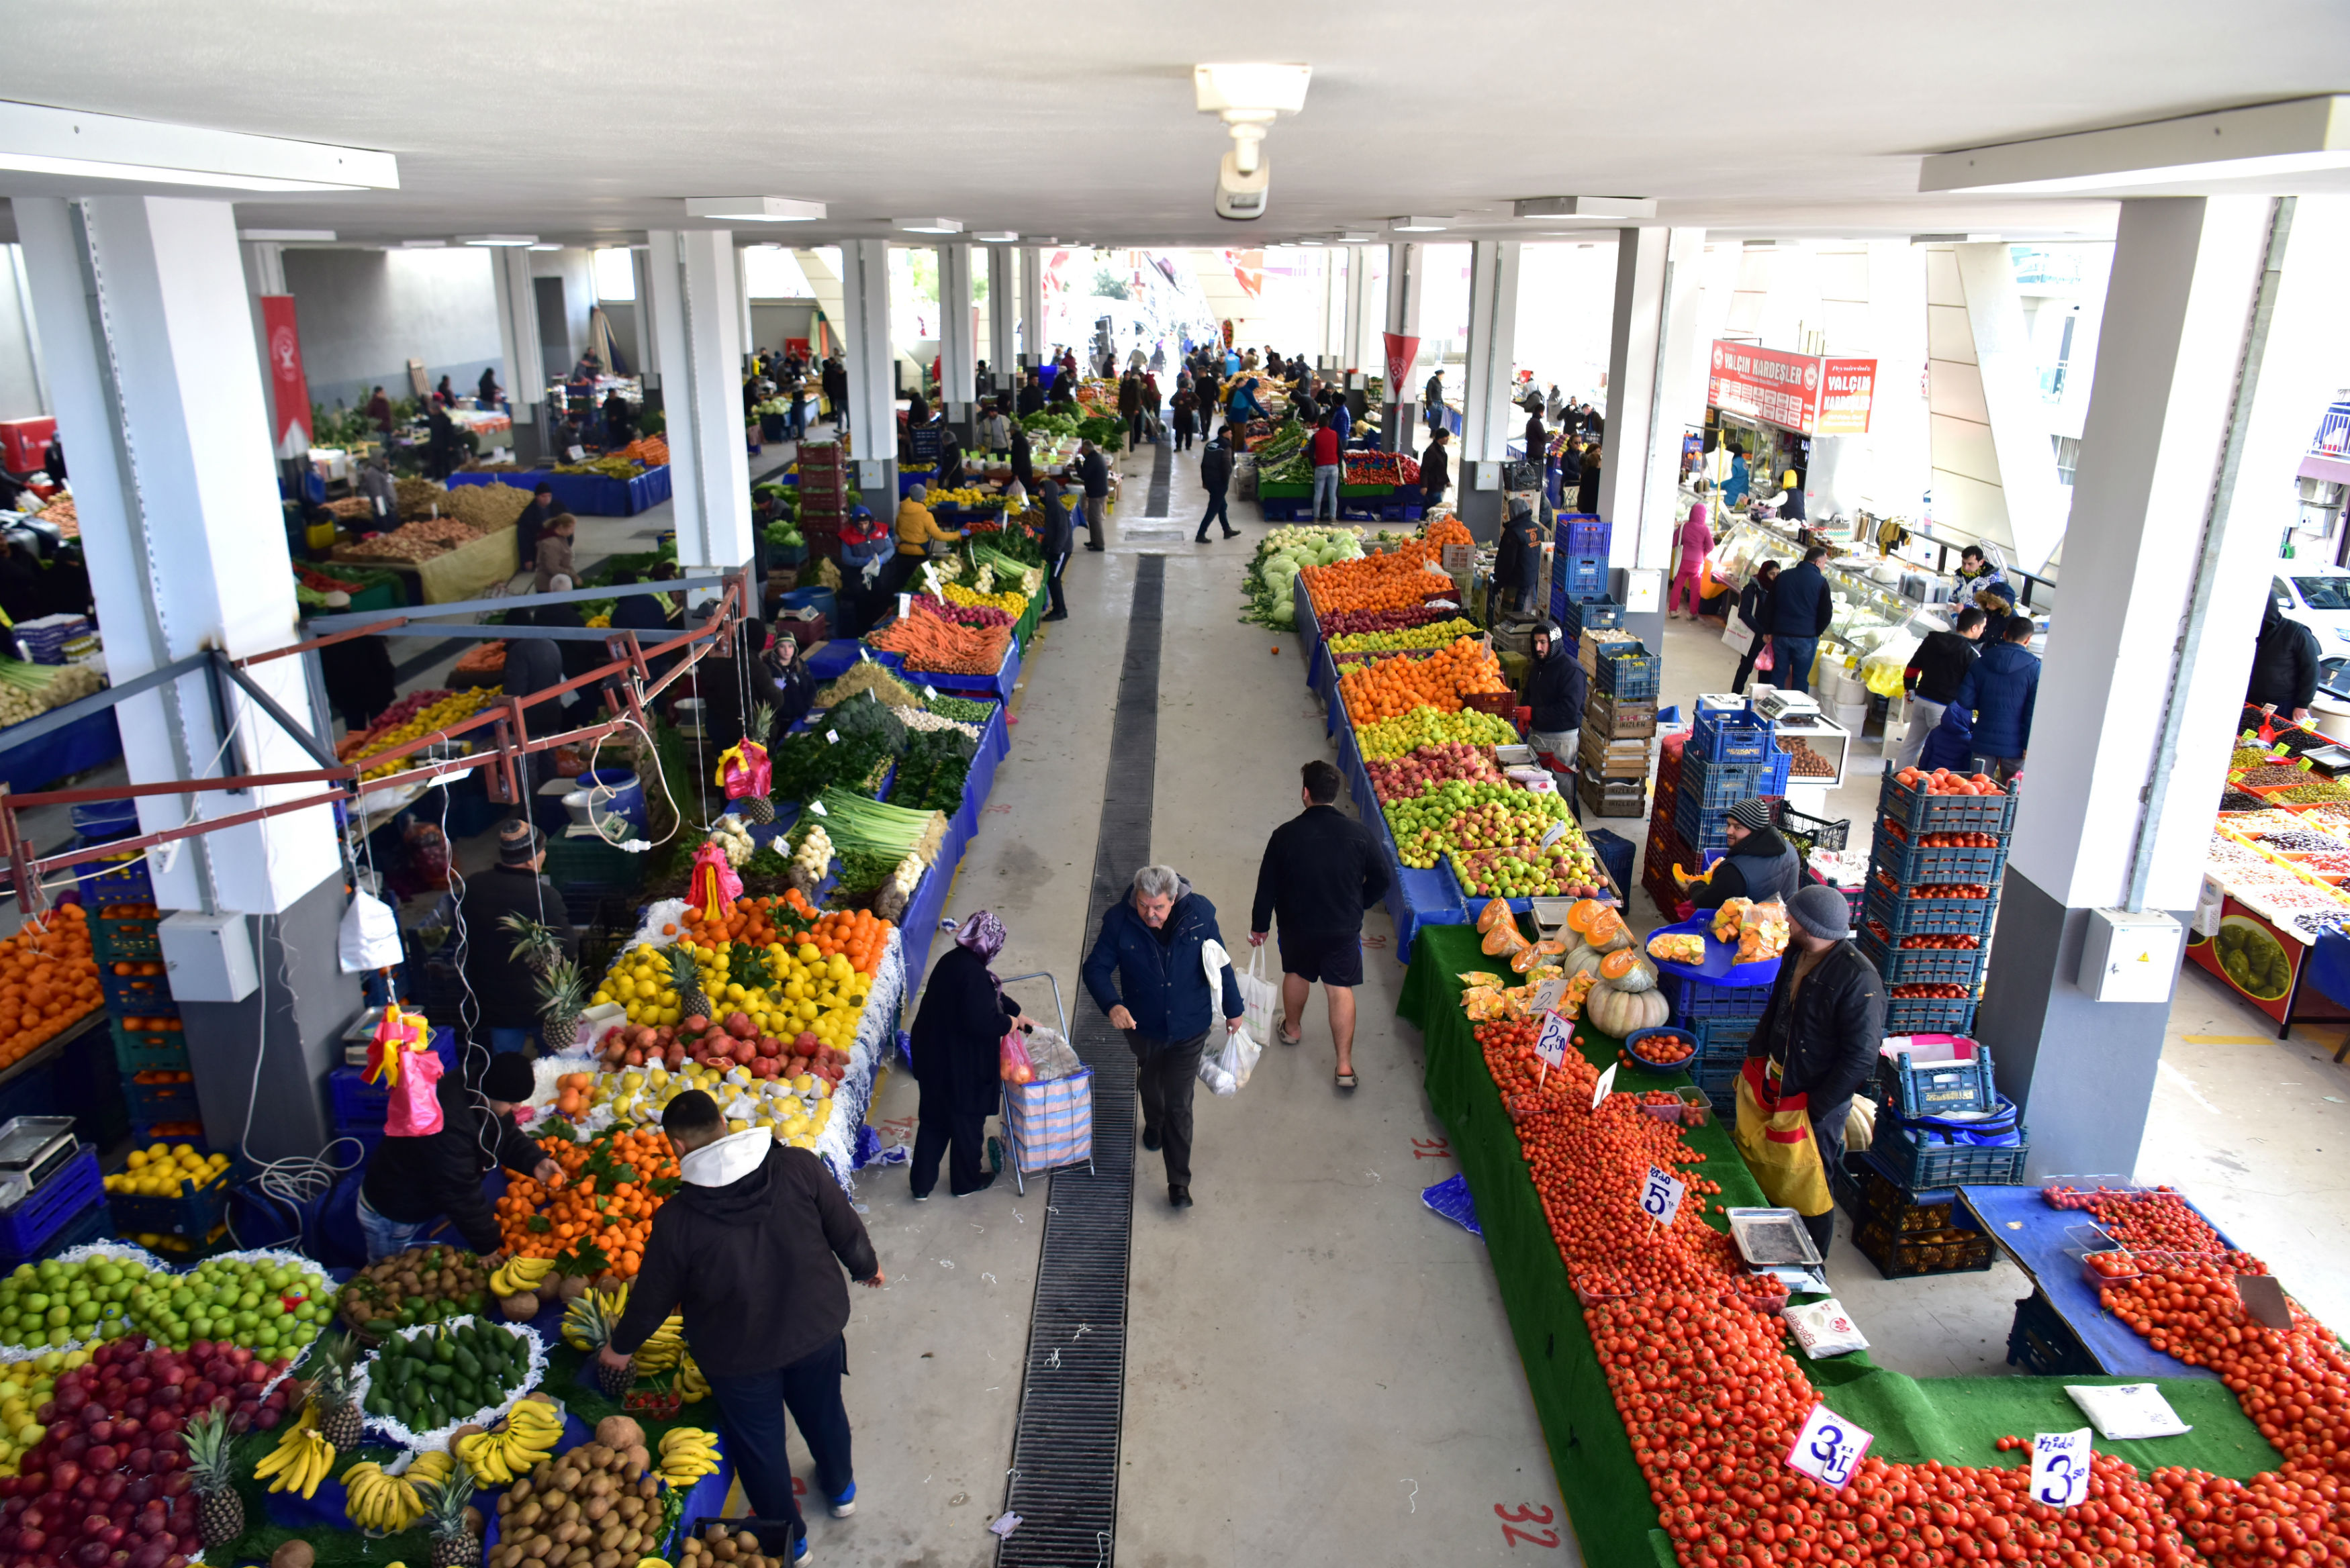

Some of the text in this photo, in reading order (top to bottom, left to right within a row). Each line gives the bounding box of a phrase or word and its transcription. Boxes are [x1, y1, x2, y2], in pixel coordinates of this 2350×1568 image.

[1725, 352, 1751, 375] YALÇIN
[1752, 358, 1802, 385] KARDEŞLER
[1828, 376, 1871, 393] YALÇIN
[1824, 396, 1871, 413] KARDEŞLER
[1532, 991, 1552, 1011] 2
[1411, 1136, 1452, 1161] 31
[1644, 1182, 1670, 1215] 5
[1786, 1310, 1817, 1347] Egeceren
[2041, 1455, 2072, 1504] 3
[1493, 1502, 1561, 1549] 32
